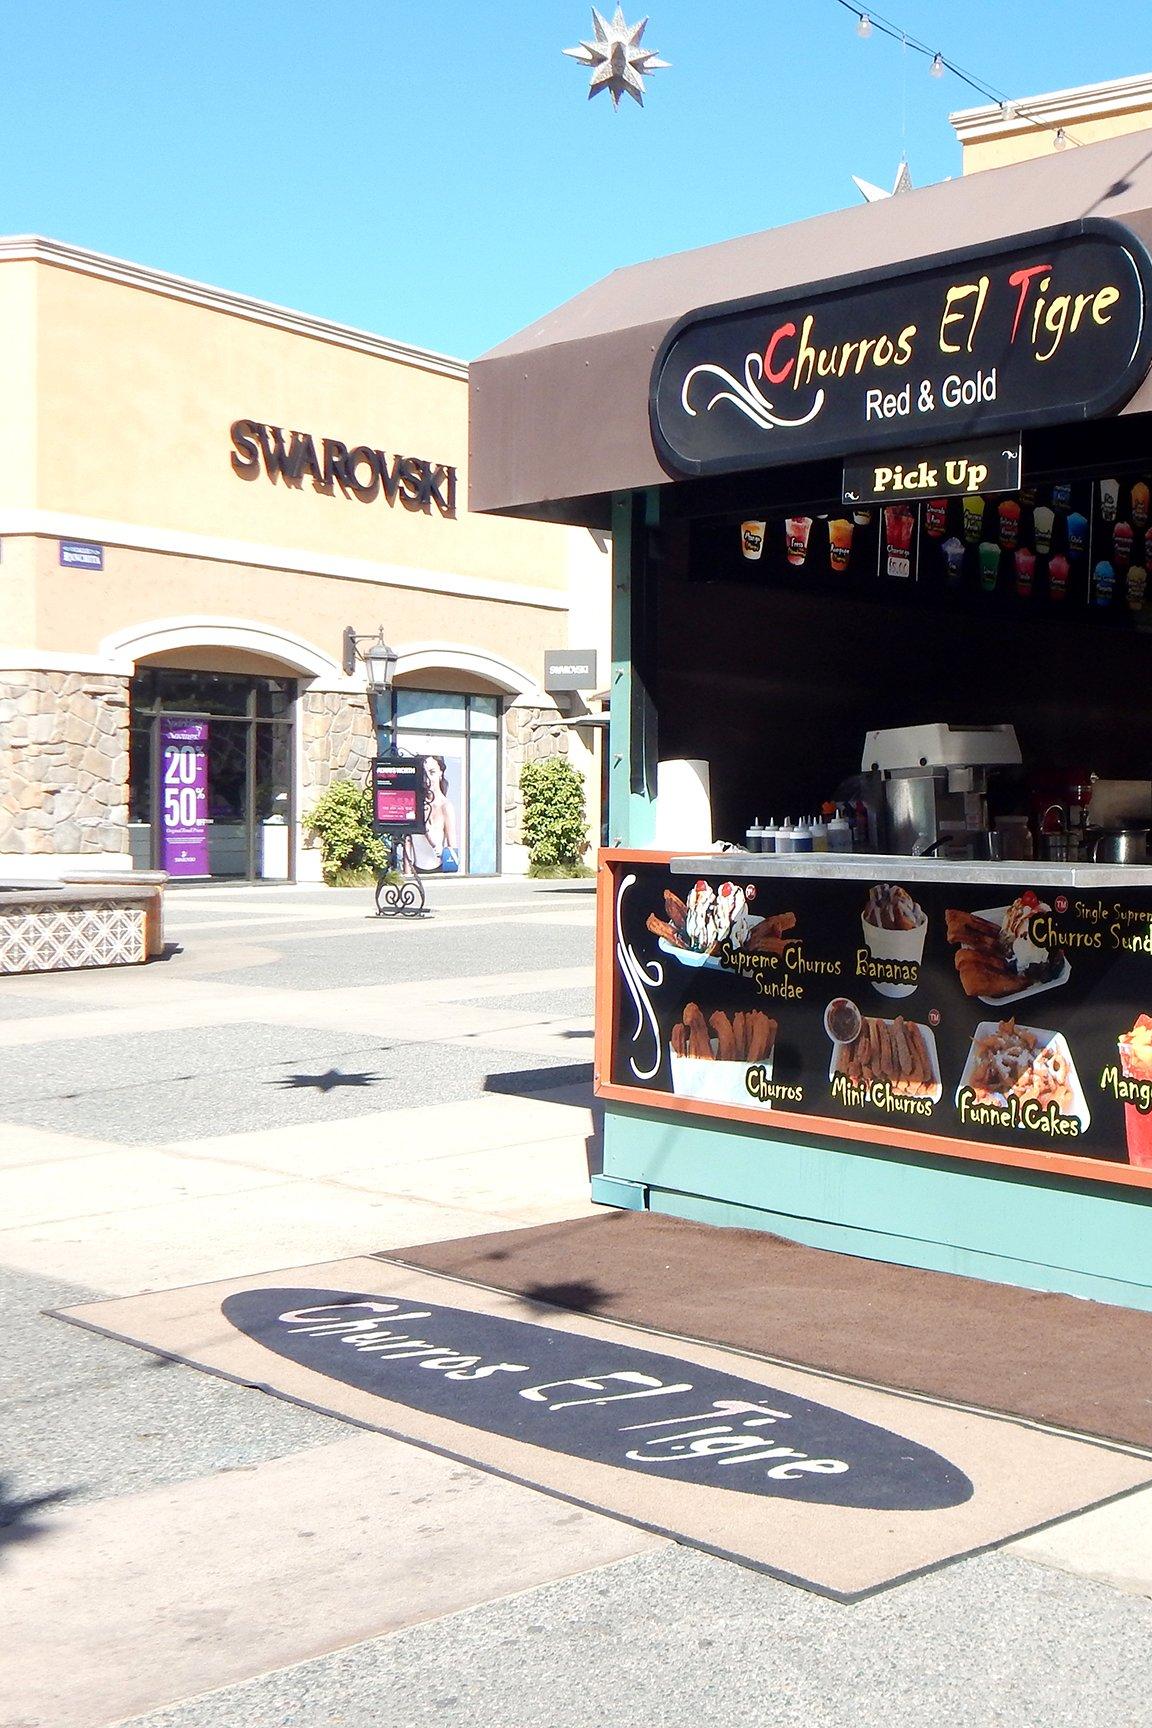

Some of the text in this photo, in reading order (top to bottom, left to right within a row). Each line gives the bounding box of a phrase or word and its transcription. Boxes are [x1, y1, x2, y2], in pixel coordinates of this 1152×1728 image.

[763, 264, 1120, 390] Churros El Tigre
[866, 368, 996, 421] Red & Gold
[231, 419, 457, 518] SWAROVSKI
[874, 459, 987, 492] Pick Up
[1075, 901, 1108, 924] Single
[1032, 917, 1102, 948] Churros
[722, 944, 842, 974] Supreme Churros
[856, 949, 918, 981] Bananas
[755, 975, 803, 999] Sundae
[747, 1070, 803, 1102] Churros
[831, 1078, 933, 1116] Mini Churros
[960, 1091, 1079, 1137] Funnel Cakes
[278, 1300, 851, 1481] Churros El Tigre
